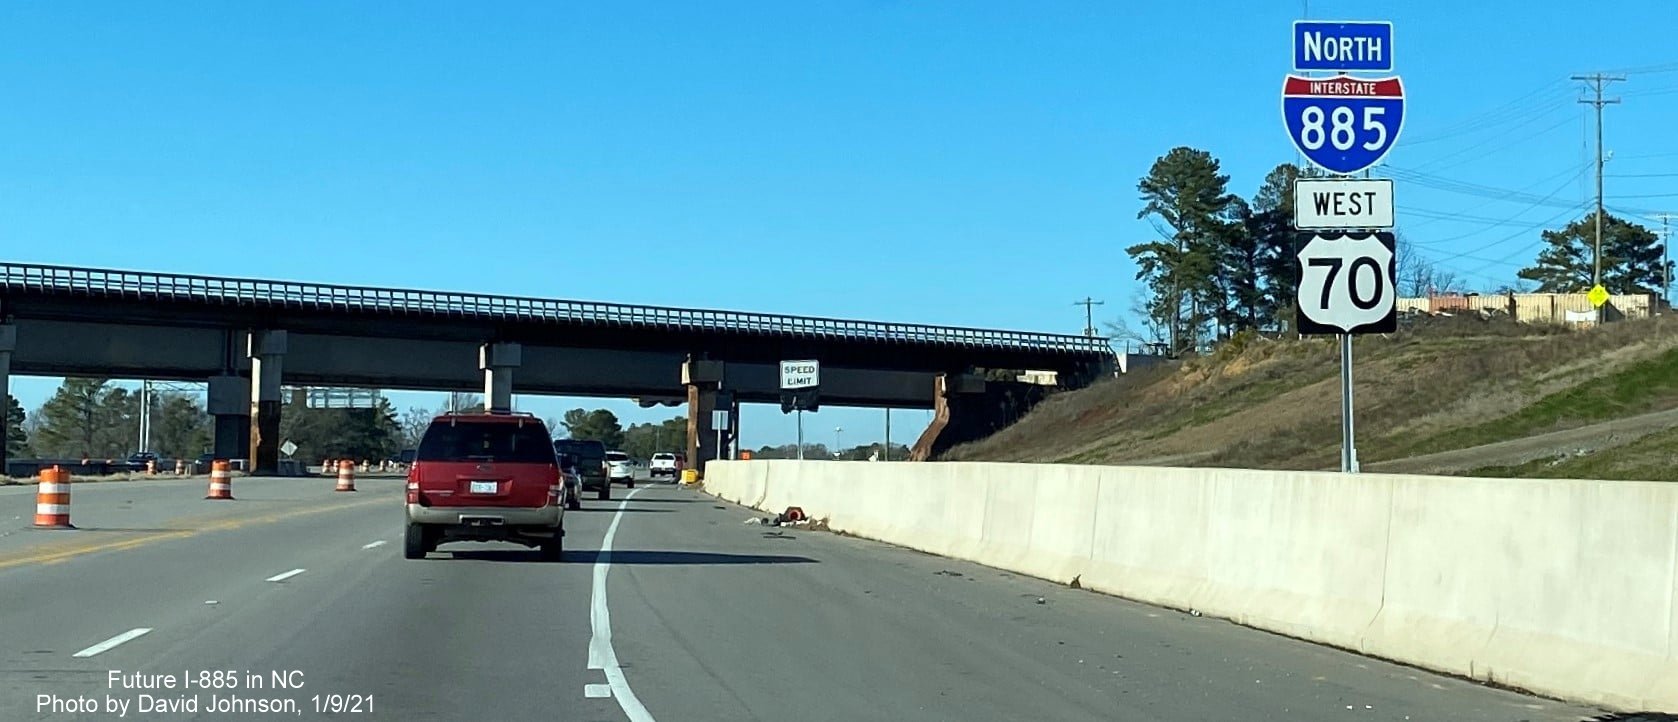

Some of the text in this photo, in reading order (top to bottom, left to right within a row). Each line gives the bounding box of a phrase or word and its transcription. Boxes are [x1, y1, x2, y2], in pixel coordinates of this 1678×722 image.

[1303, 31, 1382, 62] NORTH
[1310, 82, 1377, 95] INTERSTATE
[1301, 105, 1387, 151] 885
[1313, 192, 1377, 216] WEST
[1308, 256, 1384, 311] 70
[784, 365, 816, 374] SPEED
[787, 377, 812, 386] LIMIT
